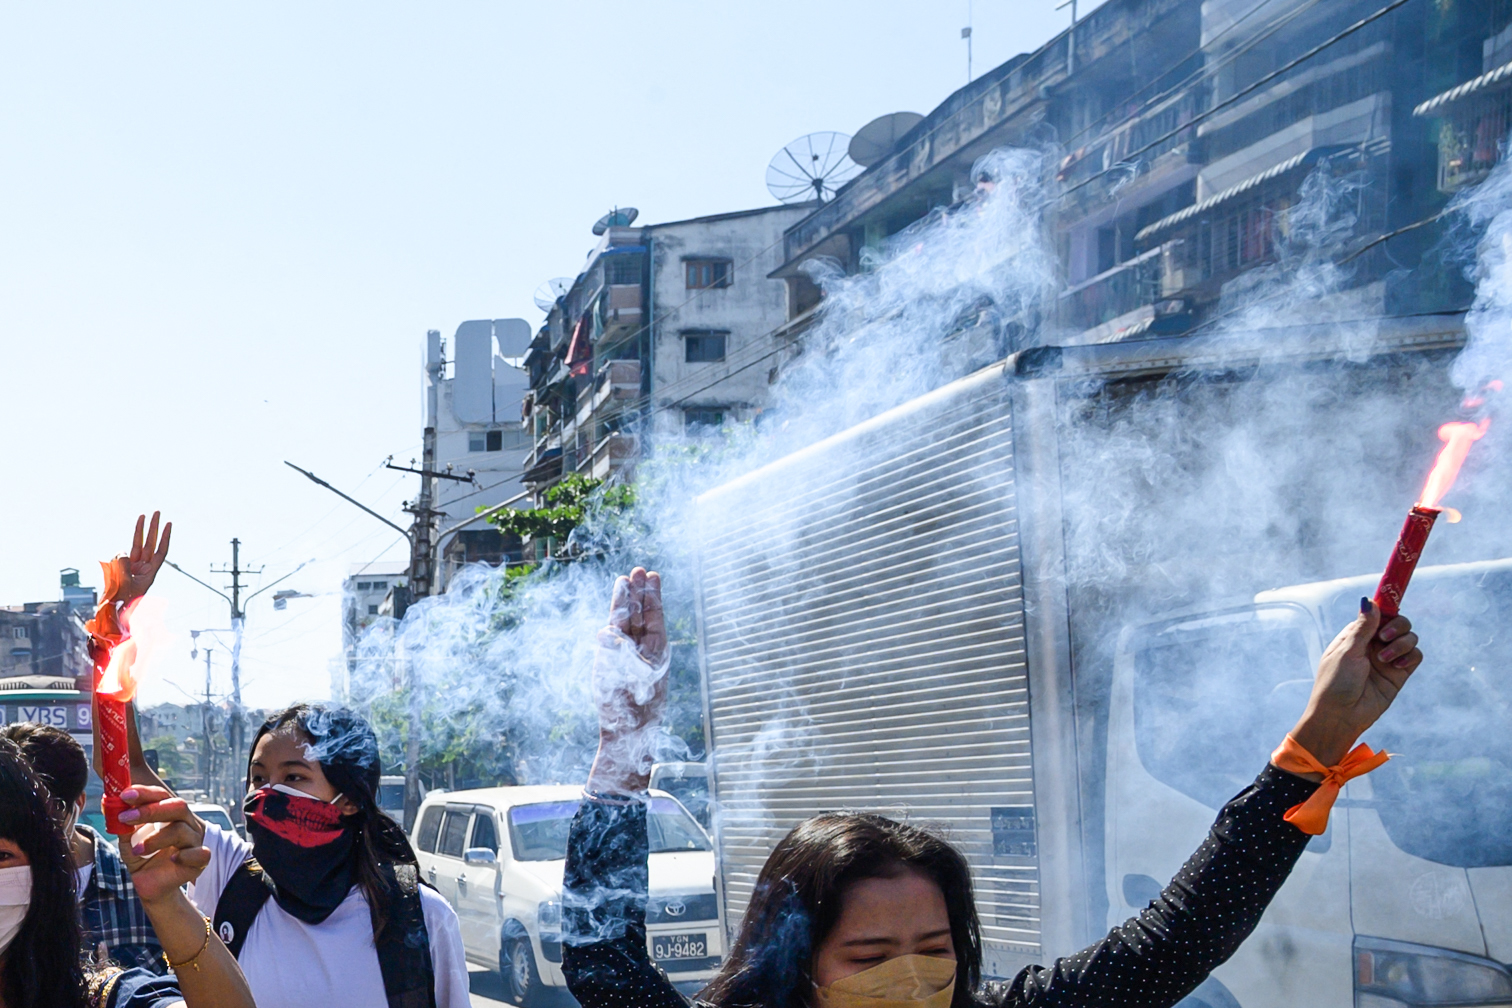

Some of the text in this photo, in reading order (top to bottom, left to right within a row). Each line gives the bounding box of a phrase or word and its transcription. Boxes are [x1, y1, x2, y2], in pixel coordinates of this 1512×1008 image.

[23, 707, 65, 726] YBS
[78, 706, 92, 726] 9
[655, 941, 705, 958] 9J-9482
